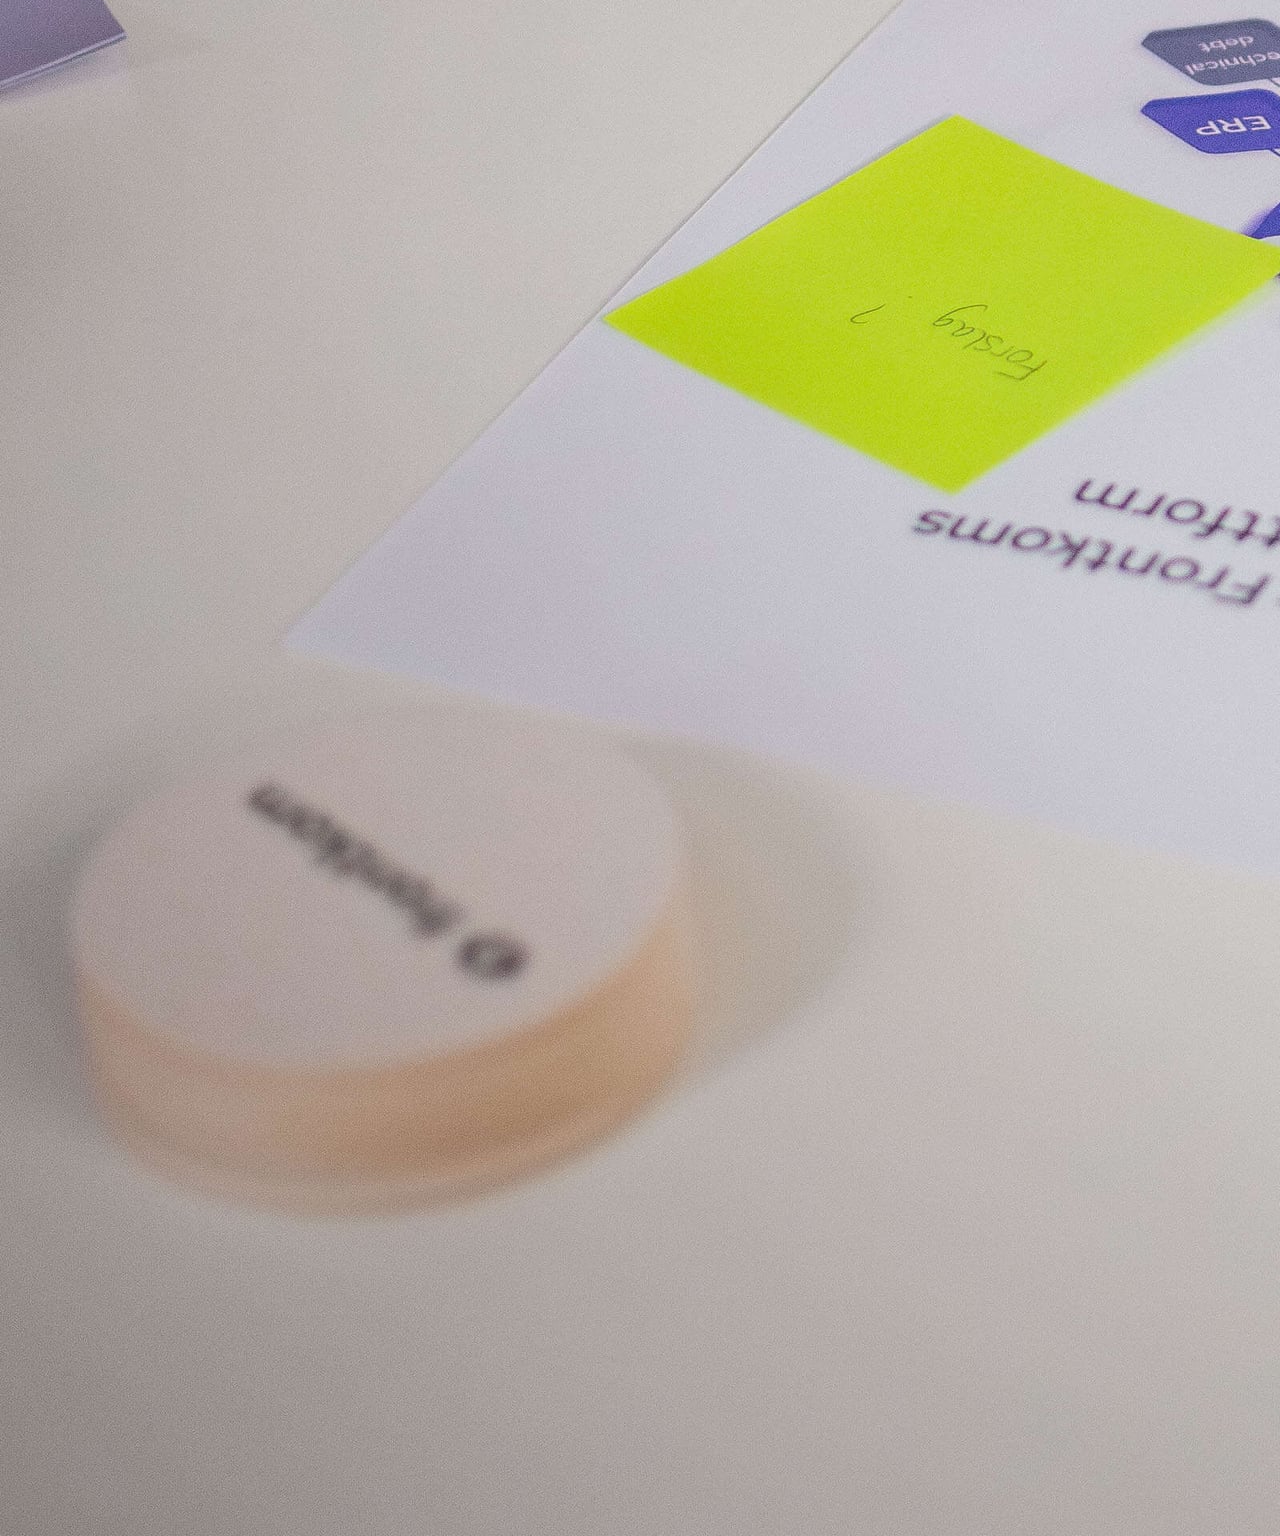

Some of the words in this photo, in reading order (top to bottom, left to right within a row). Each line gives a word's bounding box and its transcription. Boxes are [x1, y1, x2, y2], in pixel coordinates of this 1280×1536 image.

[1198, 35, 1254, 53] debt
[1195, 115, 1273, 136] ERP
[911, 507, 1272, 609] Frontkoms
